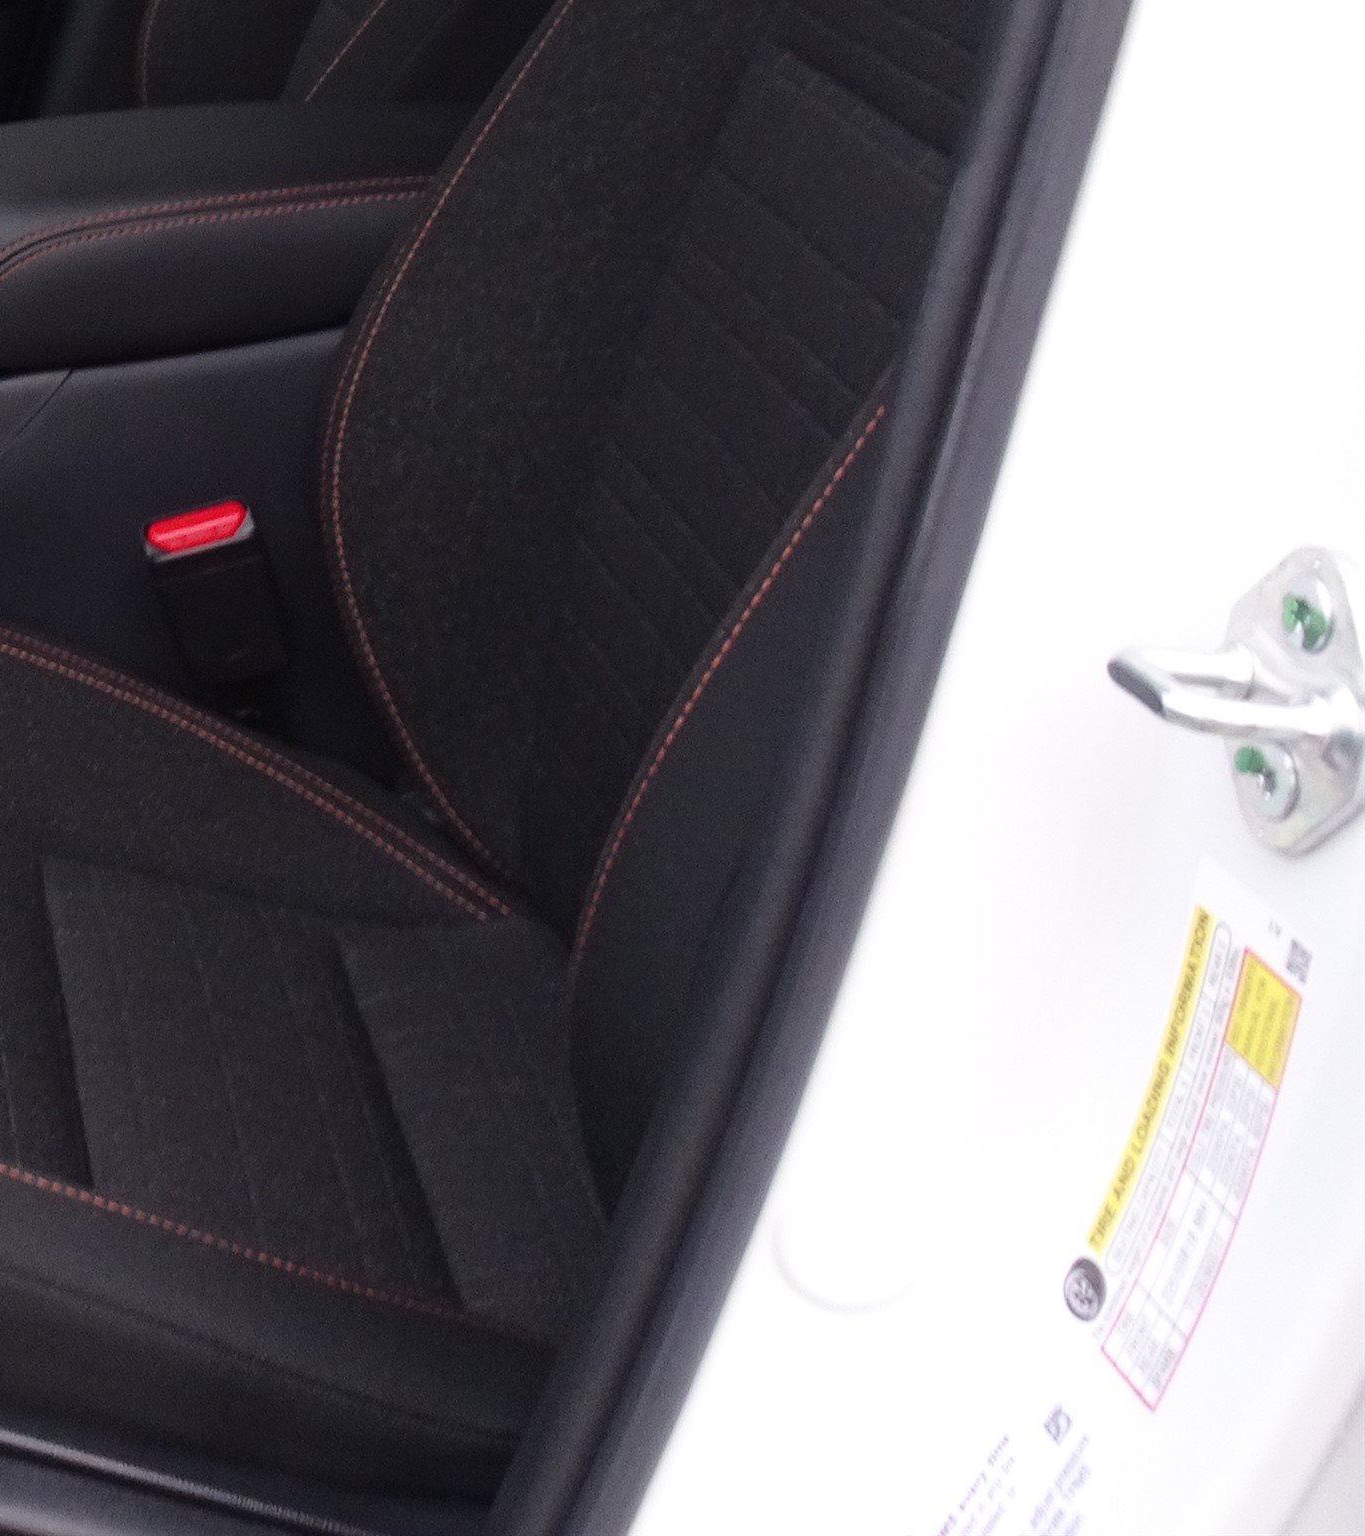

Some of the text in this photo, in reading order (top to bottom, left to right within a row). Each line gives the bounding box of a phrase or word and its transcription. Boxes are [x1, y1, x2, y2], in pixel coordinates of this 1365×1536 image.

[1114, 1155, 1136, 1201] AND
[1131, 1058, 1171, 1155] LOADING
[1165, 906, 1210, 1058] INFORMATION
